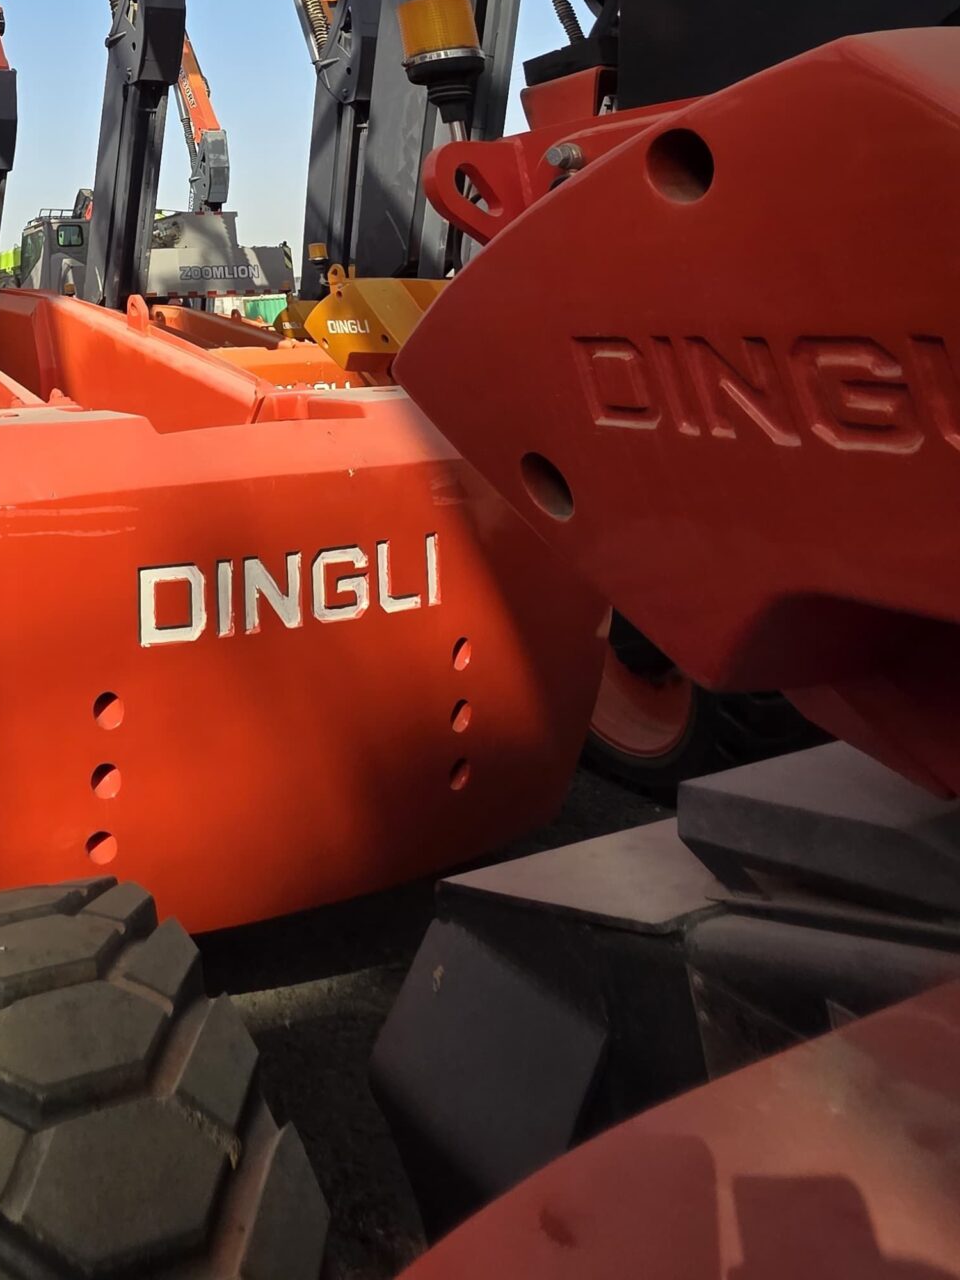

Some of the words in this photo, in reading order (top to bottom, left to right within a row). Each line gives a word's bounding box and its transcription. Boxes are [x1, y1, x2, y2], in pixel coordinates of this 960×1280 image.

[180, 264, 260, 280] ZOOMLION
[327, 319, 370, 334] DINGLI
[138, 531, 441, 648] DINGLI
